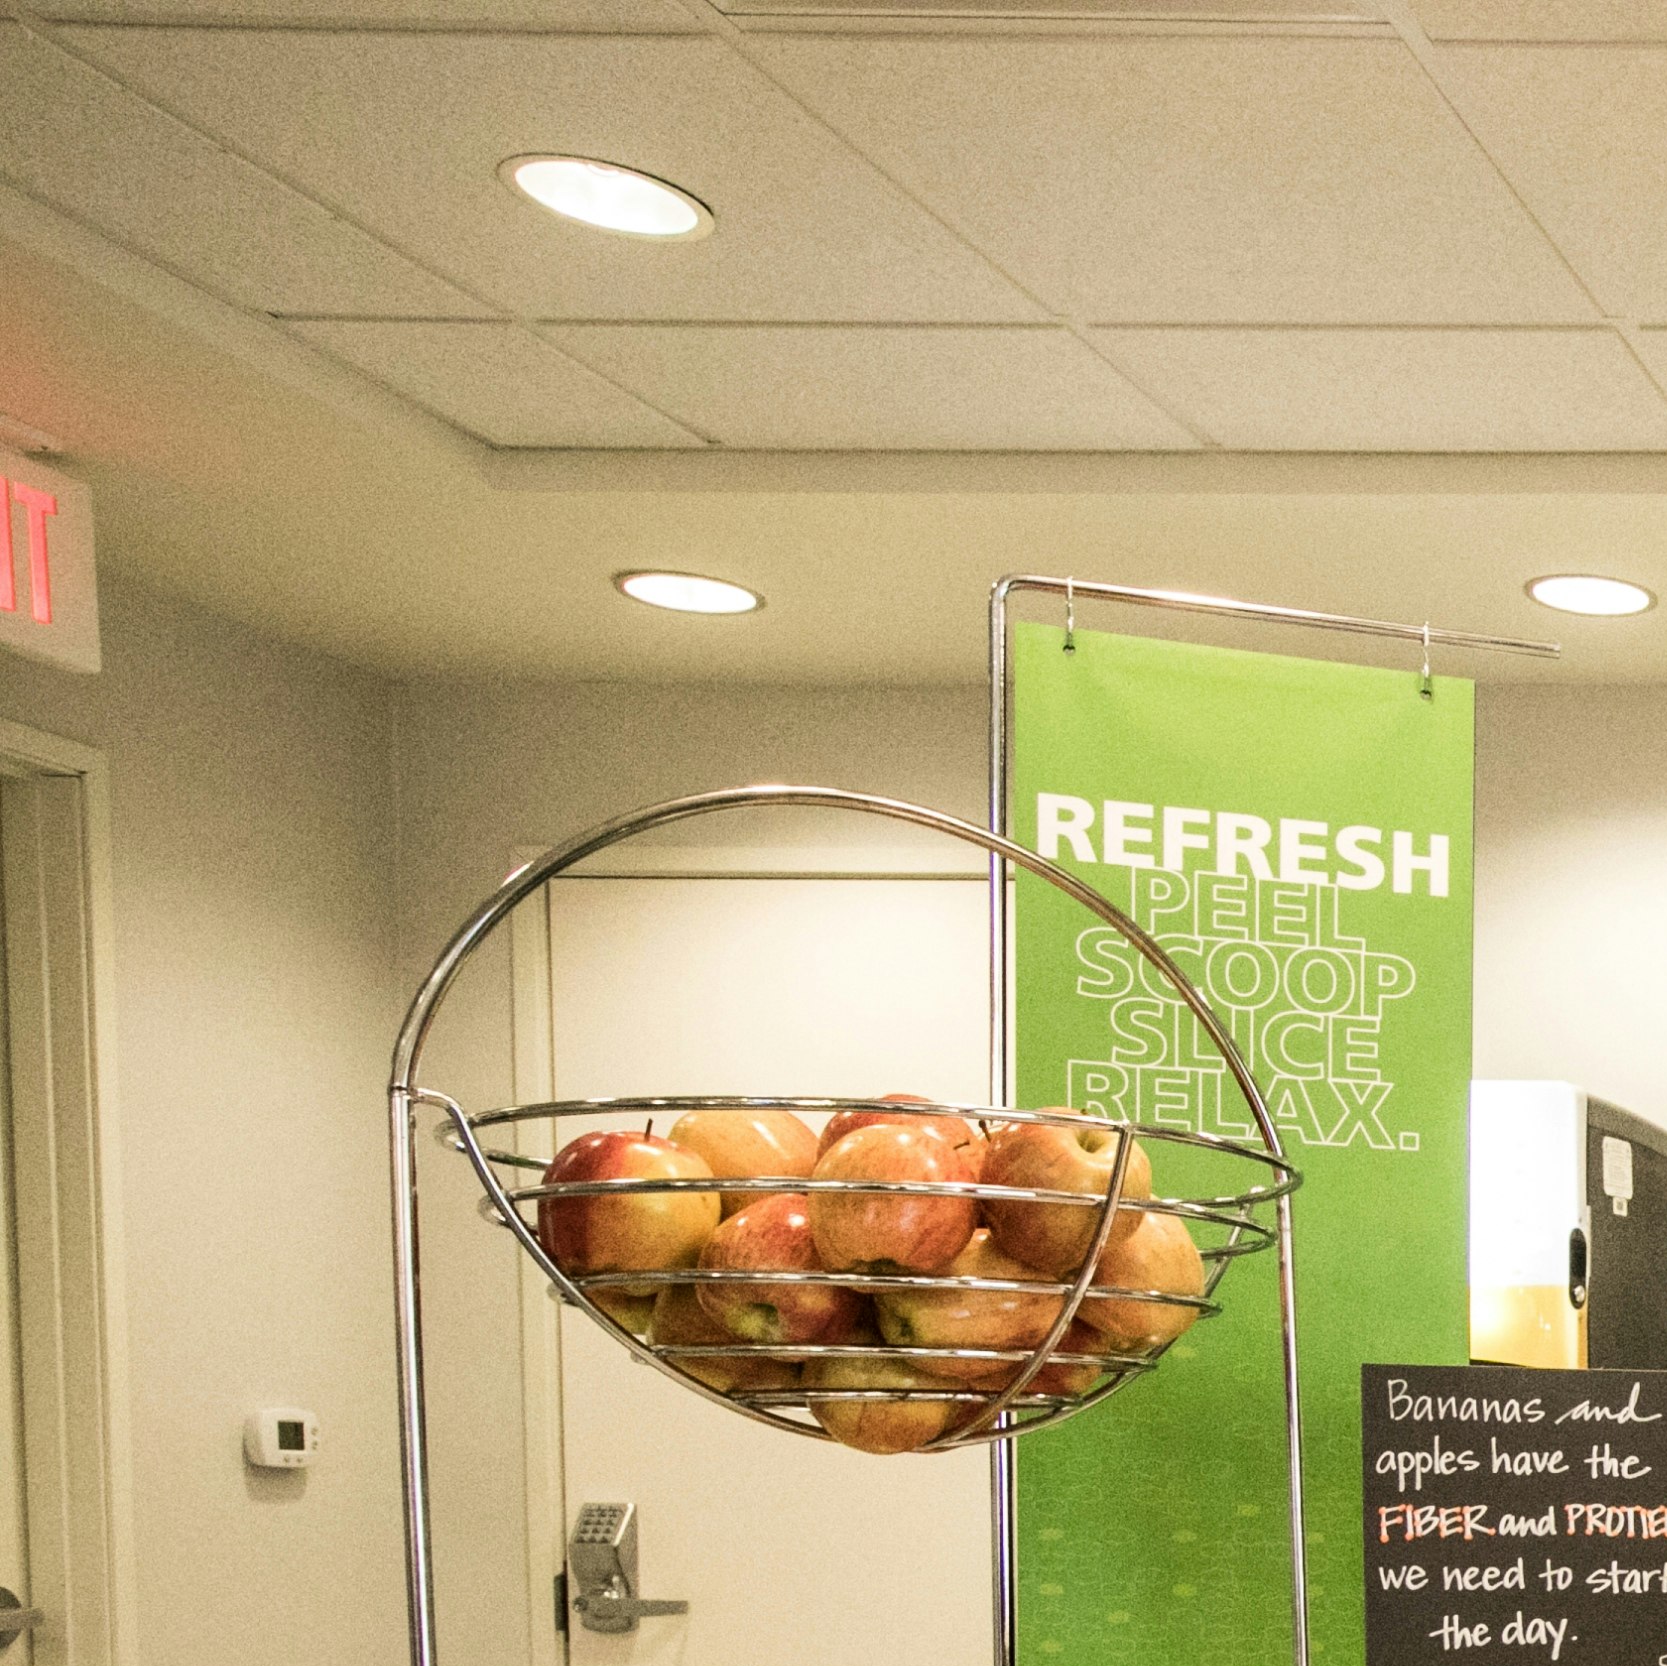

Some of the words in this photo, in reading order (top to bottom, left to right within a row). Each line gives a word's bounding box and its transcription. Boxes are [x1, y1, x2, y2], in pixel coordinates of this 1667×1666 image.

[0, 474, 57, 624] IT
[1036, 792, 1450, 898] REFRESH
[1131, 866, 1366, 952] PEEL
[1076, 927, 1417, 1020] SCOOP
[1110, 998, 1381, 1083] SLICE
[1067, 1060, 1420, 1151] RELAX.
[1387, 1379, 1546, 1422] Bananas
[1554, 1382, 1662, 1425] and
[1375, 1435, 1480, 1492] apples
[1491, 1437, 1569, 1476] have
[1584, 1443, 1652, 1479] the
[1379, 1503, 1496, 1543] FIBER
[1500, 1506, 1557, 1537] and
[1379, 1565, 1429, 1590] we
[1443, 1557, 1525, 1590] need
[1539, 1559, 1573, 1591] to
[1429, 1614, 1491, 1650] the
[1502, 1611, 1578, 1661] day.
